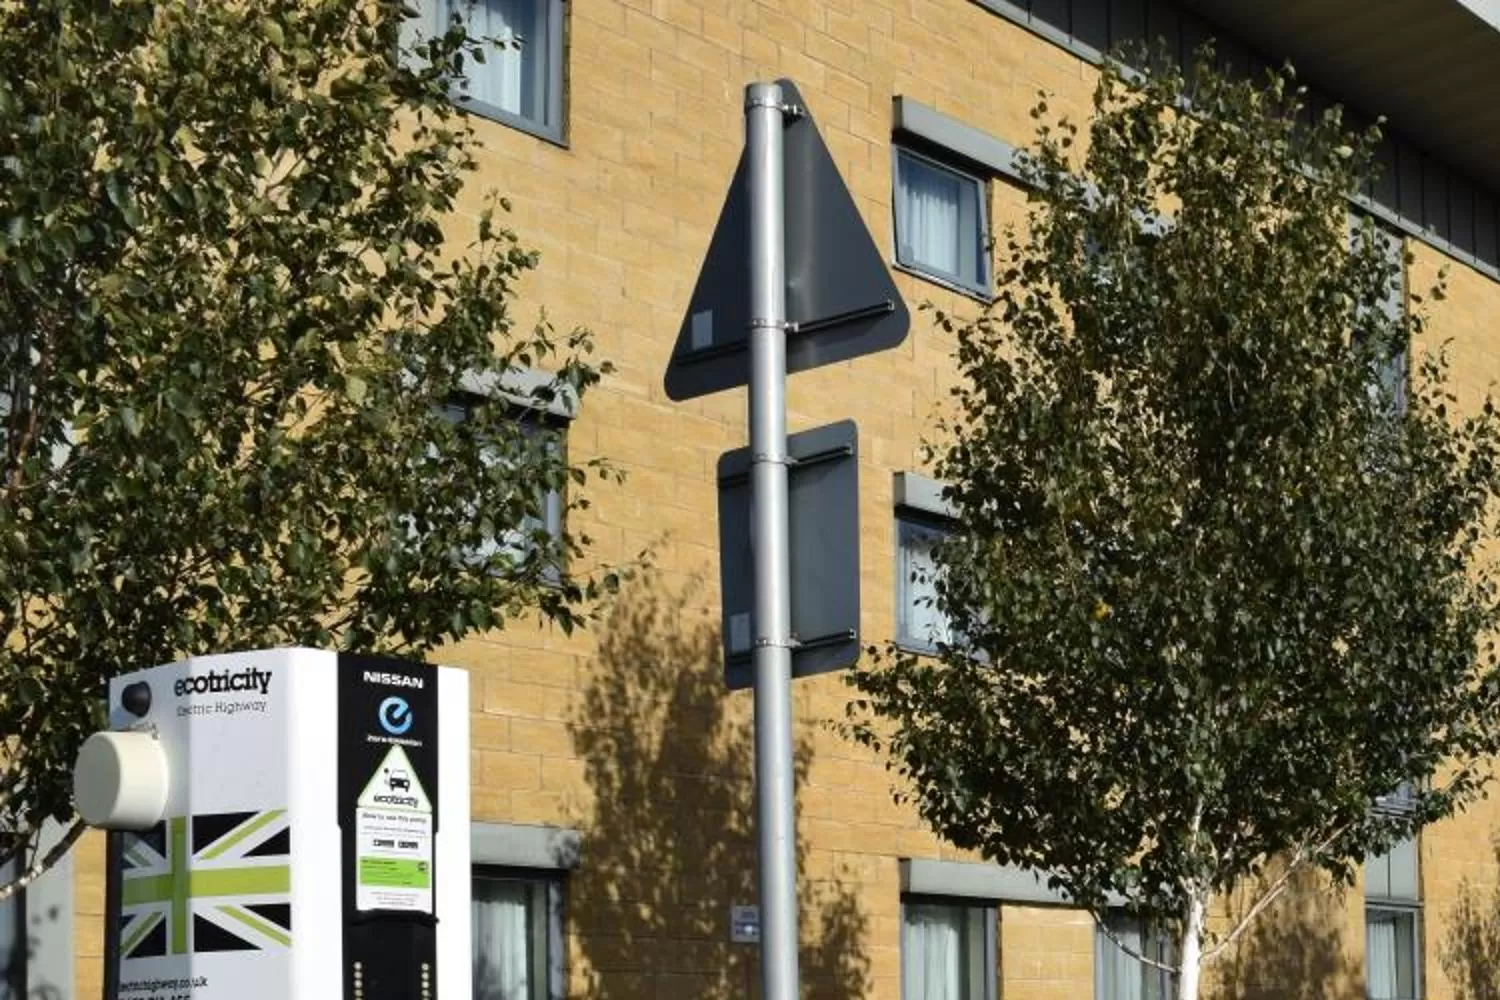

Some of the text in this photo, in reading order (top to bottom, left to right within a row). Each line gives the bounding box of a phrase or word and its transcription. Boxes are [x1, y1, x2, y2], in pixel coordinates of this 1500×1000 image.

[174, 667, 272, 697] ecotricity
[363, 671, 424, 689] NISSAN
[215, 701, 267, 715] Highway
